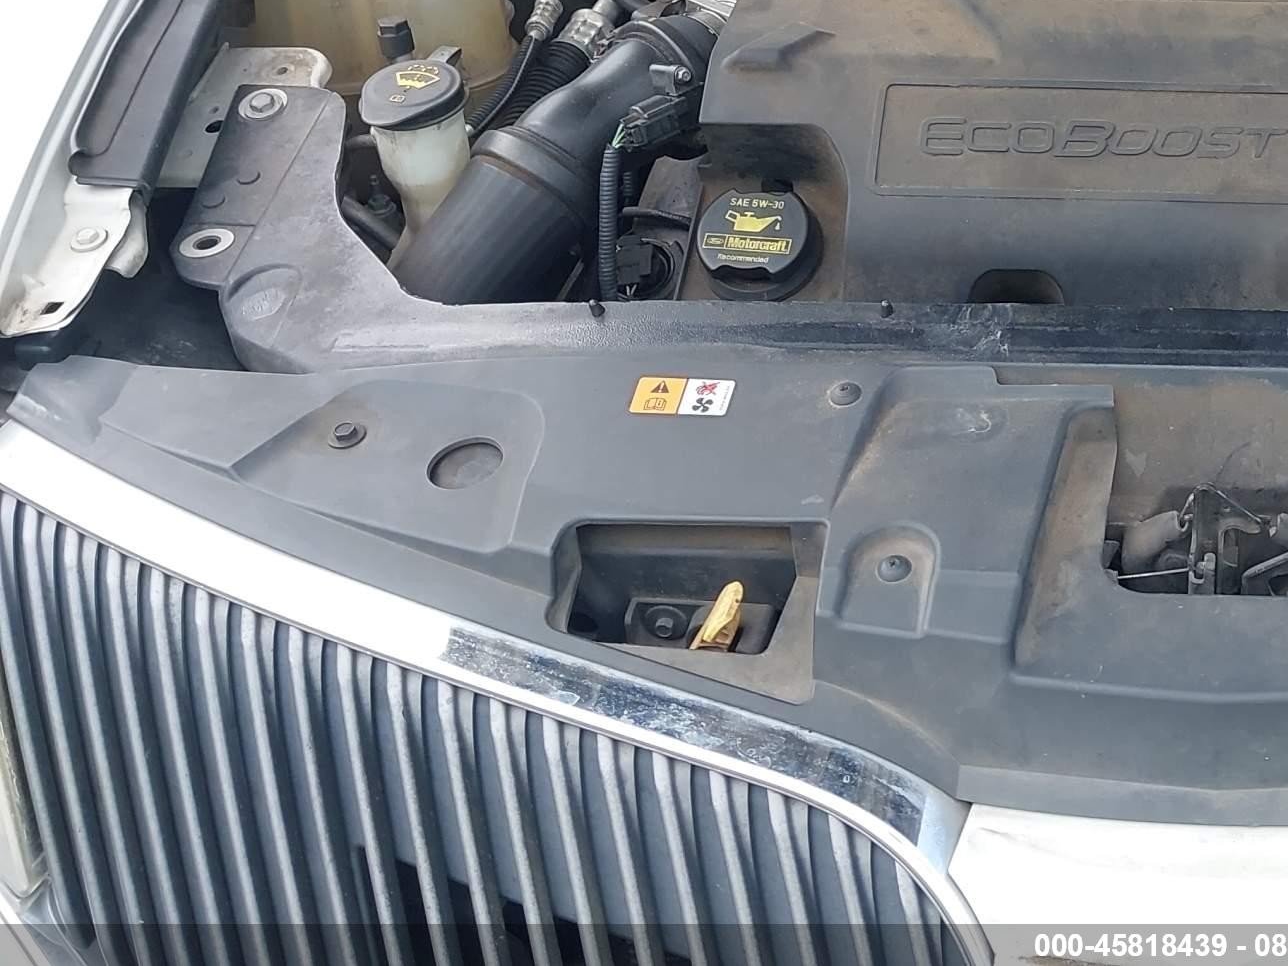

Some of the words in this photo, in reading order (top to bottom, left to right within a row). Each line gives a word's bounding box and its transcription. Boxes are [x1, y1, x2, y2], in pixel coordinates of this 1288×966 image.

[730, 198, 750, 207] SAE
[752, 199, 785, 209] 5W-30
[727, 236, 788, 252] Motorcraft
[717, 253, 769, 263] Recommended
